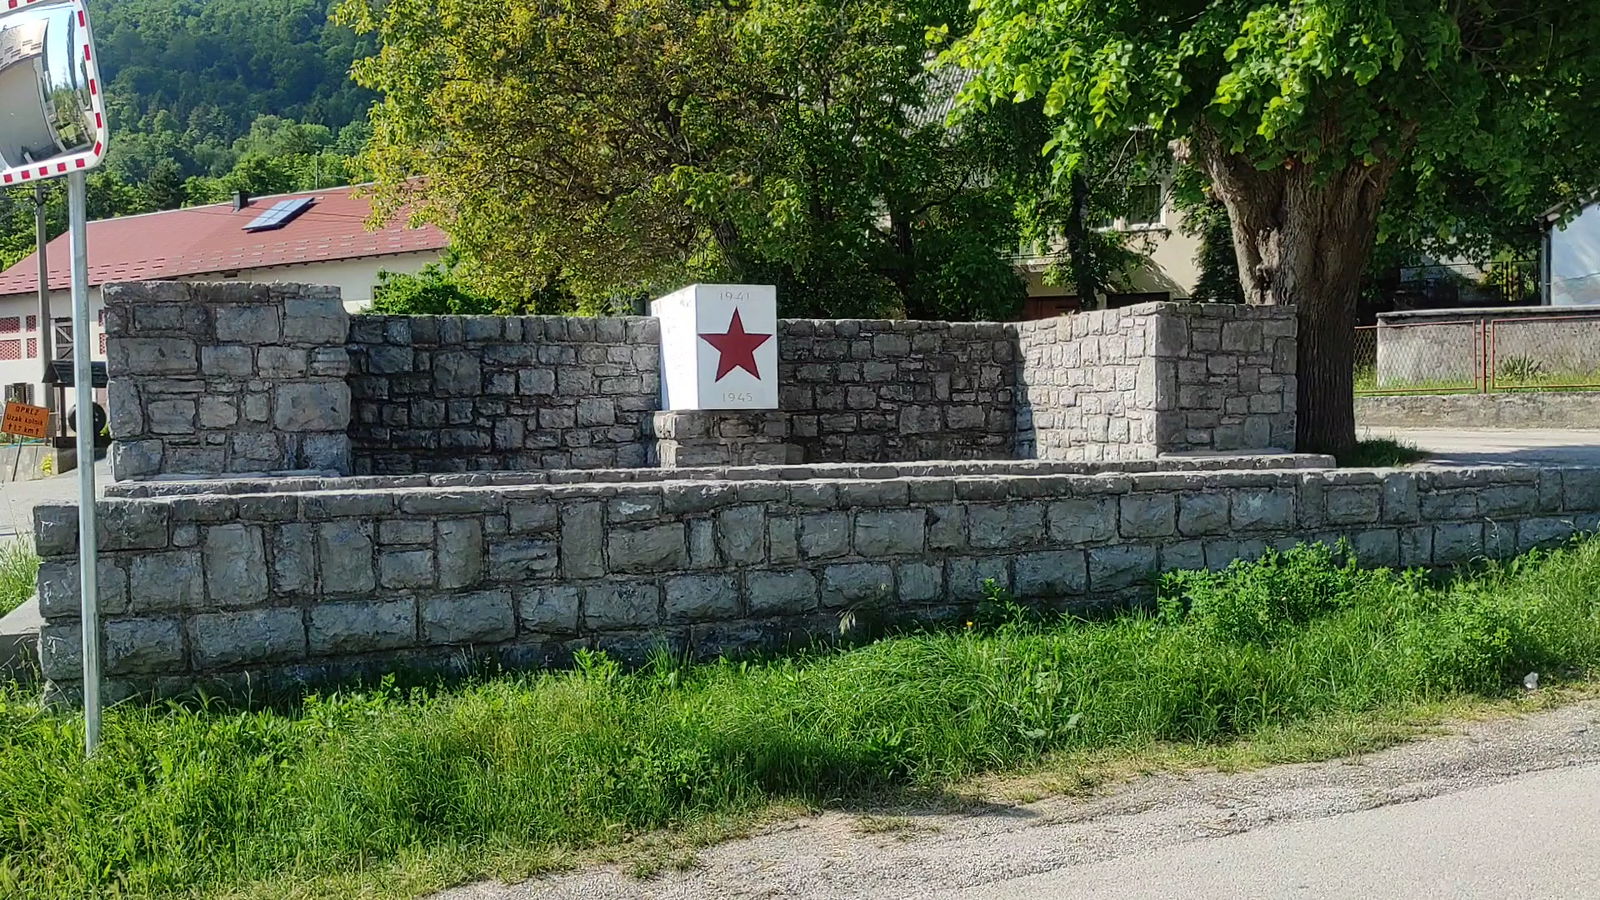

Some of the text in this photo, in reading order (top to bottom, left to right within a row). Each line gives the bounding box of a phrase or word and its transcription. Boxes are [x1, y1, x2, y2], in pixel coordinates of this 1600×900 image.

[720, 292, 749, 301] 1941
[722, 392, 753, 402] 1945
[15, 405, 39, 415] OPREZ
[24, 426, 34, 434] km
